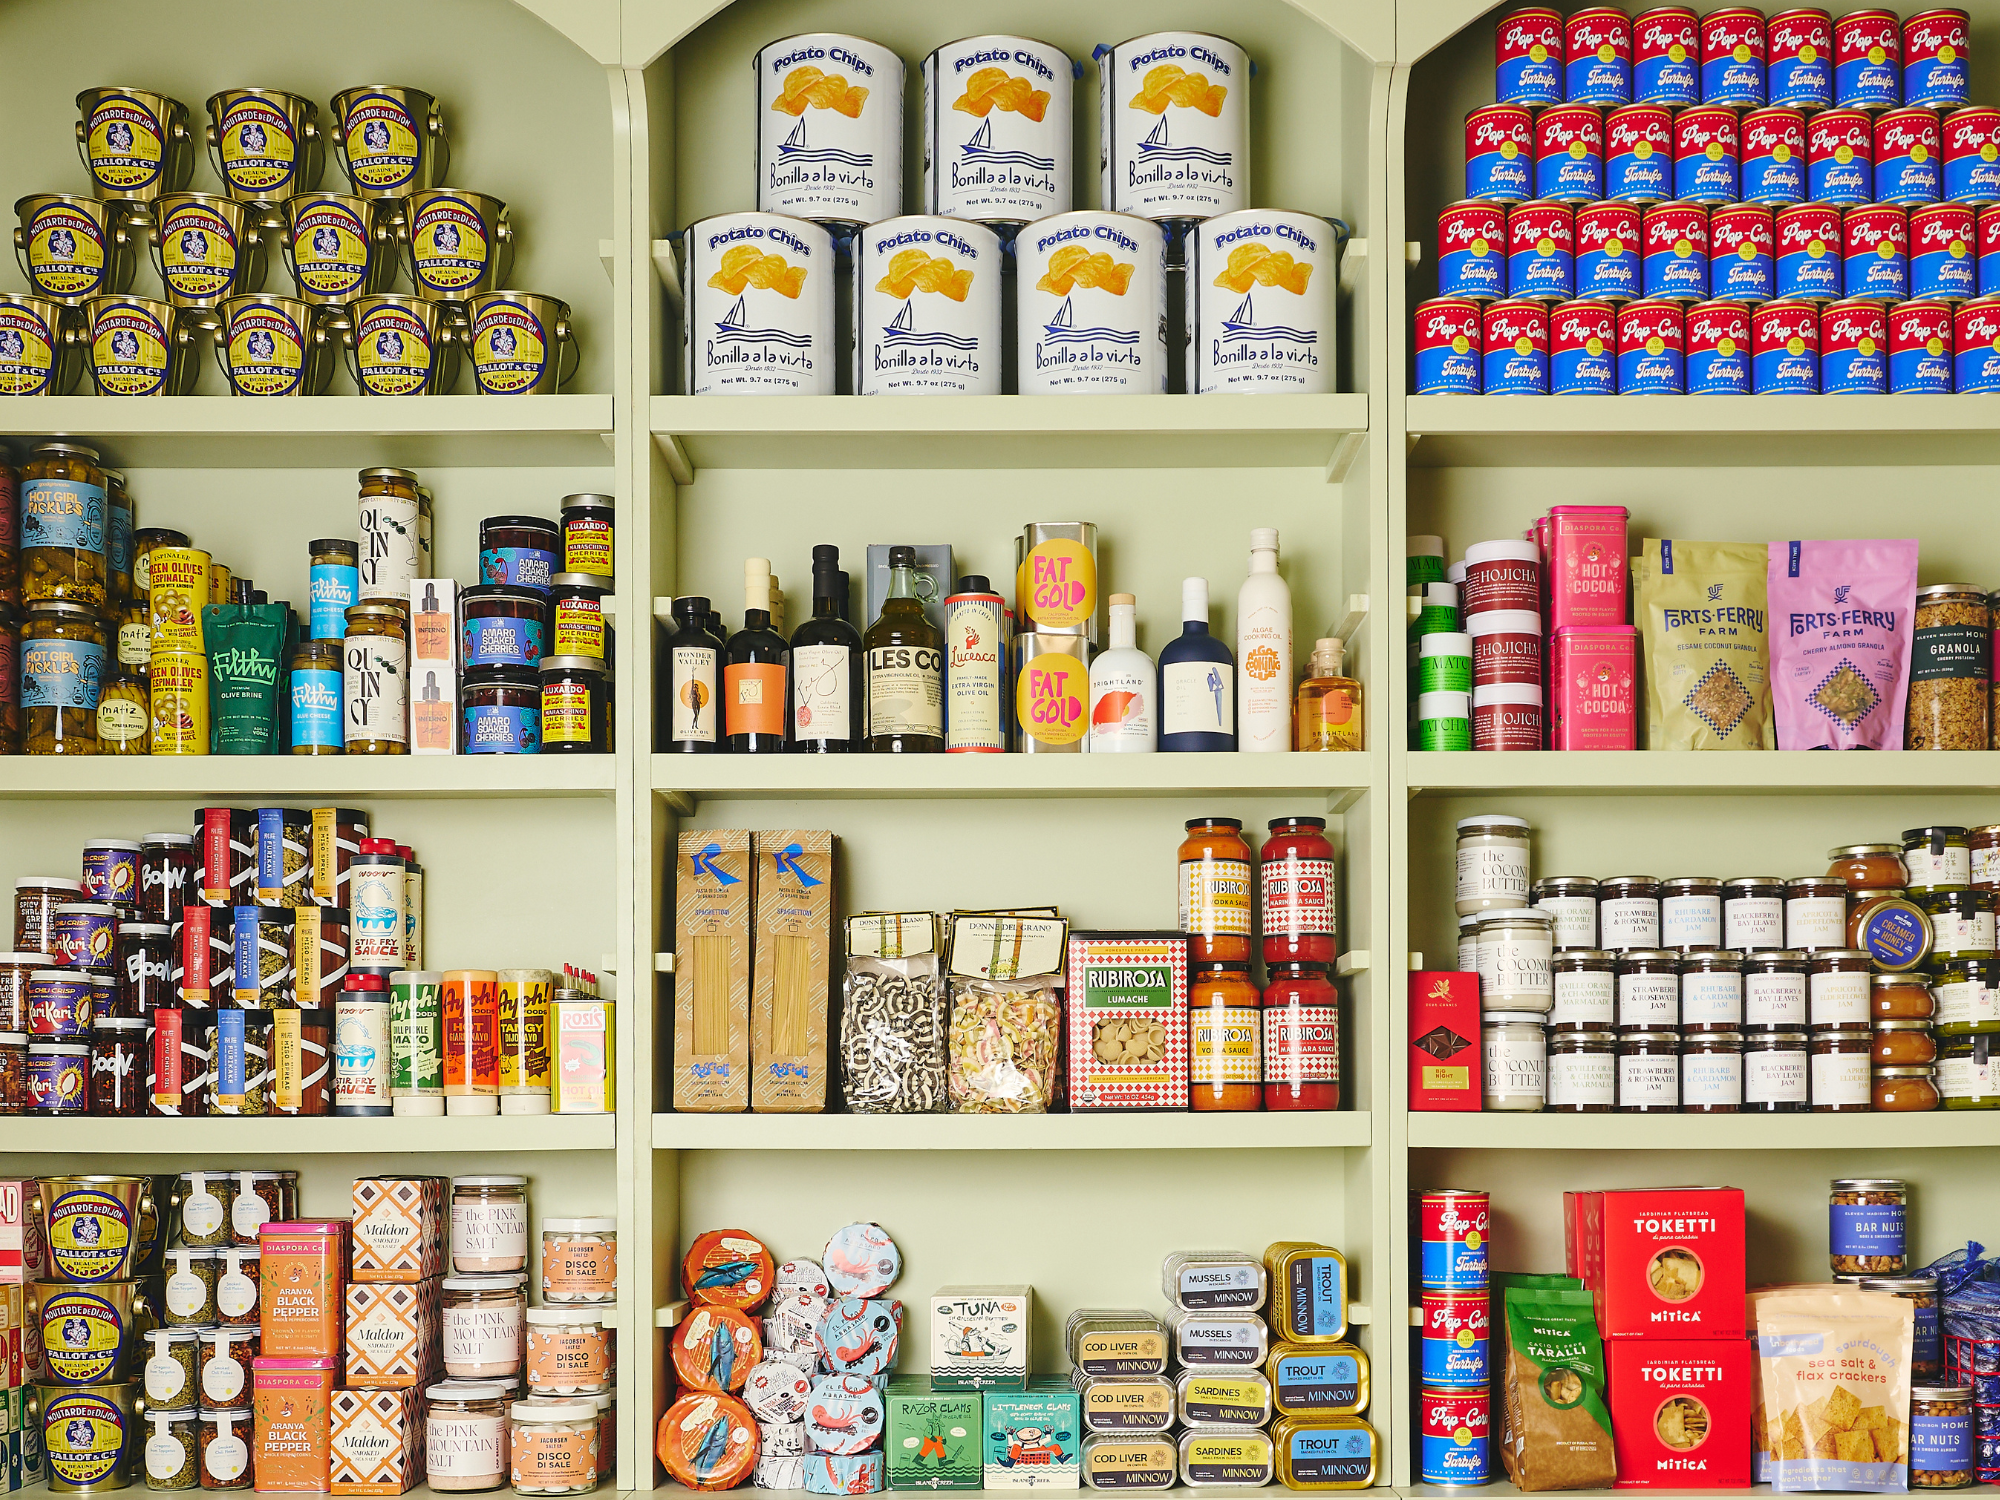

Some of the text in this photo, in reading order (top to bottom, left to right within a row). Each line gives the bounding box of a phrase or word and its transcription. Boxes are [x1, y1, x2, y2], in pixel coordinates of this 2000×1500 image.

[773, 47, 874, 76] Potato Chips
[94, 158, 130, 167] FALLOT
[102, 173, 141, 186] DIJON
[770, 163, 809, 189] Bonilla
[823, 165, 835, 182] la
[709, 225, 811, 257] Potato Chips
[1215, 223, 1317, 252] Potato Chips
[30, 492, 80, 503] HOT GIRL
[28, 501, 83, 516] PICKLES
[569, 522, 607, 531] LUXARDO
[370, 532, 388, 558] IN
[170, 564, 202, 576] OLIVES
[1034, 556, 1072, 584] FAT
[1481, 568, 1536, 582] HOJICHA
[1582, 564, 1607, 578] HOT
[152, 574, 195, 585] ESPINALER
[1573, 580, 1614, 594] COCOA
[1034, 580, 1085, 611] GOLD
[482, 629, 515, 637] AMARO
[482, 637, 515, 645] SOAKED
[480, 645, 519, 654] CHERRIES
[1734, 644, 1757, 652] GRANOLA
[1803, 643, 1884, 655] CHERRY ALMOND GRANOLA
[1931, 643, 1980, 654] GRANOLA
[873, 650, 910, 670] LES
[950, 646, 996, 667] Lucesca
[213, 648, 277, 685] Filthy
[1249, 670, 1276, 681] CLUB
[1094, 679, 1142, 689] BRIGHTLAND
[1270, 880, 1322, 894] RUBIROSA
[969, 922, 999, 931] DONNE
[1020, 924, 1051, 932] GRANO
[1881, 919, 1915, 942] CREAMED
[1881, 930, 1904, 949] HONEY
[355, 946, 399, 956] SAUCE
[1089, 970, 1167, 988] RUBIROSA
[454, 1023, 484, 1032] HOT
[501, 1024, 543, 1032] TANGY
[393, 1035, 429, 1044] MAYO
[1489, 1044, 1510, 1058] the
[1489, 1060, 1544, 1072] COCONUT
[1489, 1074, 1540, 1087] BUTTER
[466, 1209, 516, 1220] the PINK
[364, 1225, 410, 1236] Maldon
[466, 1222, 525, 1234] MOUNTAIN
[1634, 1219, 1716, 1233] TOKETTI
[1856, 1222, 1904, 1232] BAR NUTS
[466, 1238, 497, 1249] SALT
[56, 1249, 99, 1258] FALLOT
[66, 1264, 109, 1276] DIJON
[1189, 1274, 1231, 1283] MUSSELS
[277, 1297, 314, 1306] BLACK
[1214, 1292, 1252, 1302] MINNOW
[273, 1307, 318, 1317] PEPPER
[953, 1302, 1000, 1316] TUNA
[1086, 1342, 1138, 1351] COD LIVER
[1528, 1347, 1586, 1357] TARALLI
[1116, 1361, 1158, 1370] MINNOW
[1809, 1358, 1876, 1369] sea salt &
[1797, 1370, 1887, 1383] flax crackers
[1195, 1387, 1240, 1397] SARDINES
[902, 1403, 971, 1415] RAZOR CLAMS
[1220, 1409, 1259, 1420] MINNOW
[1299, 1439, 1339, 1449] TROUT
[1321, 1464, 1368, 1475] MINNOW
